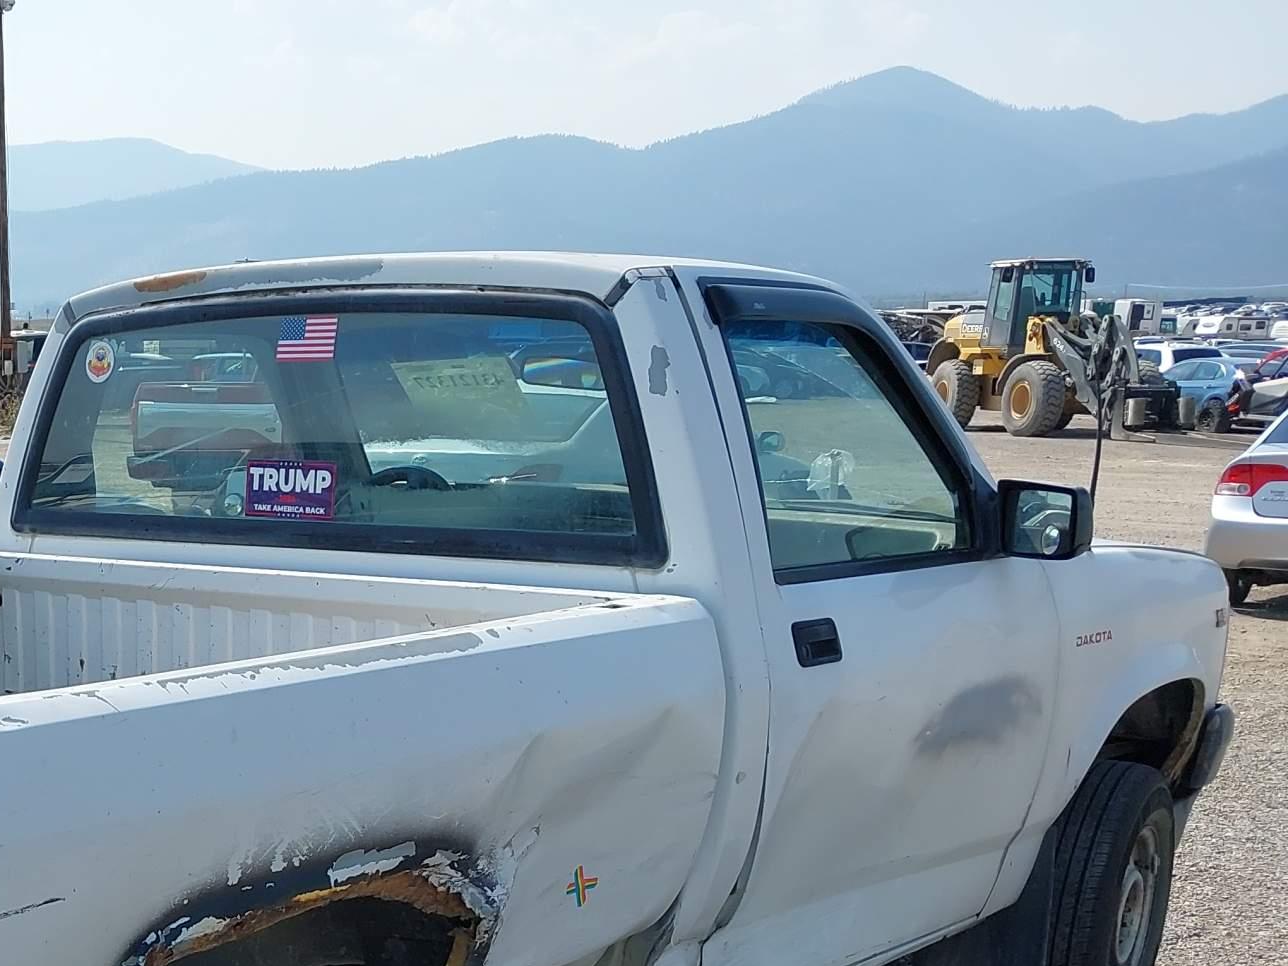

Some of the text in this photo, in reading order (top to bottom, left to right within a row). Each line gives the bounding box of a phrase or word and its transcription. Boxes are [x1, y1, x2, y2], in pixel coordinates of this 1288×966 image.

[962, 323, 983, 333] DEER
[249, 466, 332, 494] TRUMP
[253, 503, 326, 515] TAKE AMERICA BACK
[1075, 629, 1113, 647] DAKOTA
